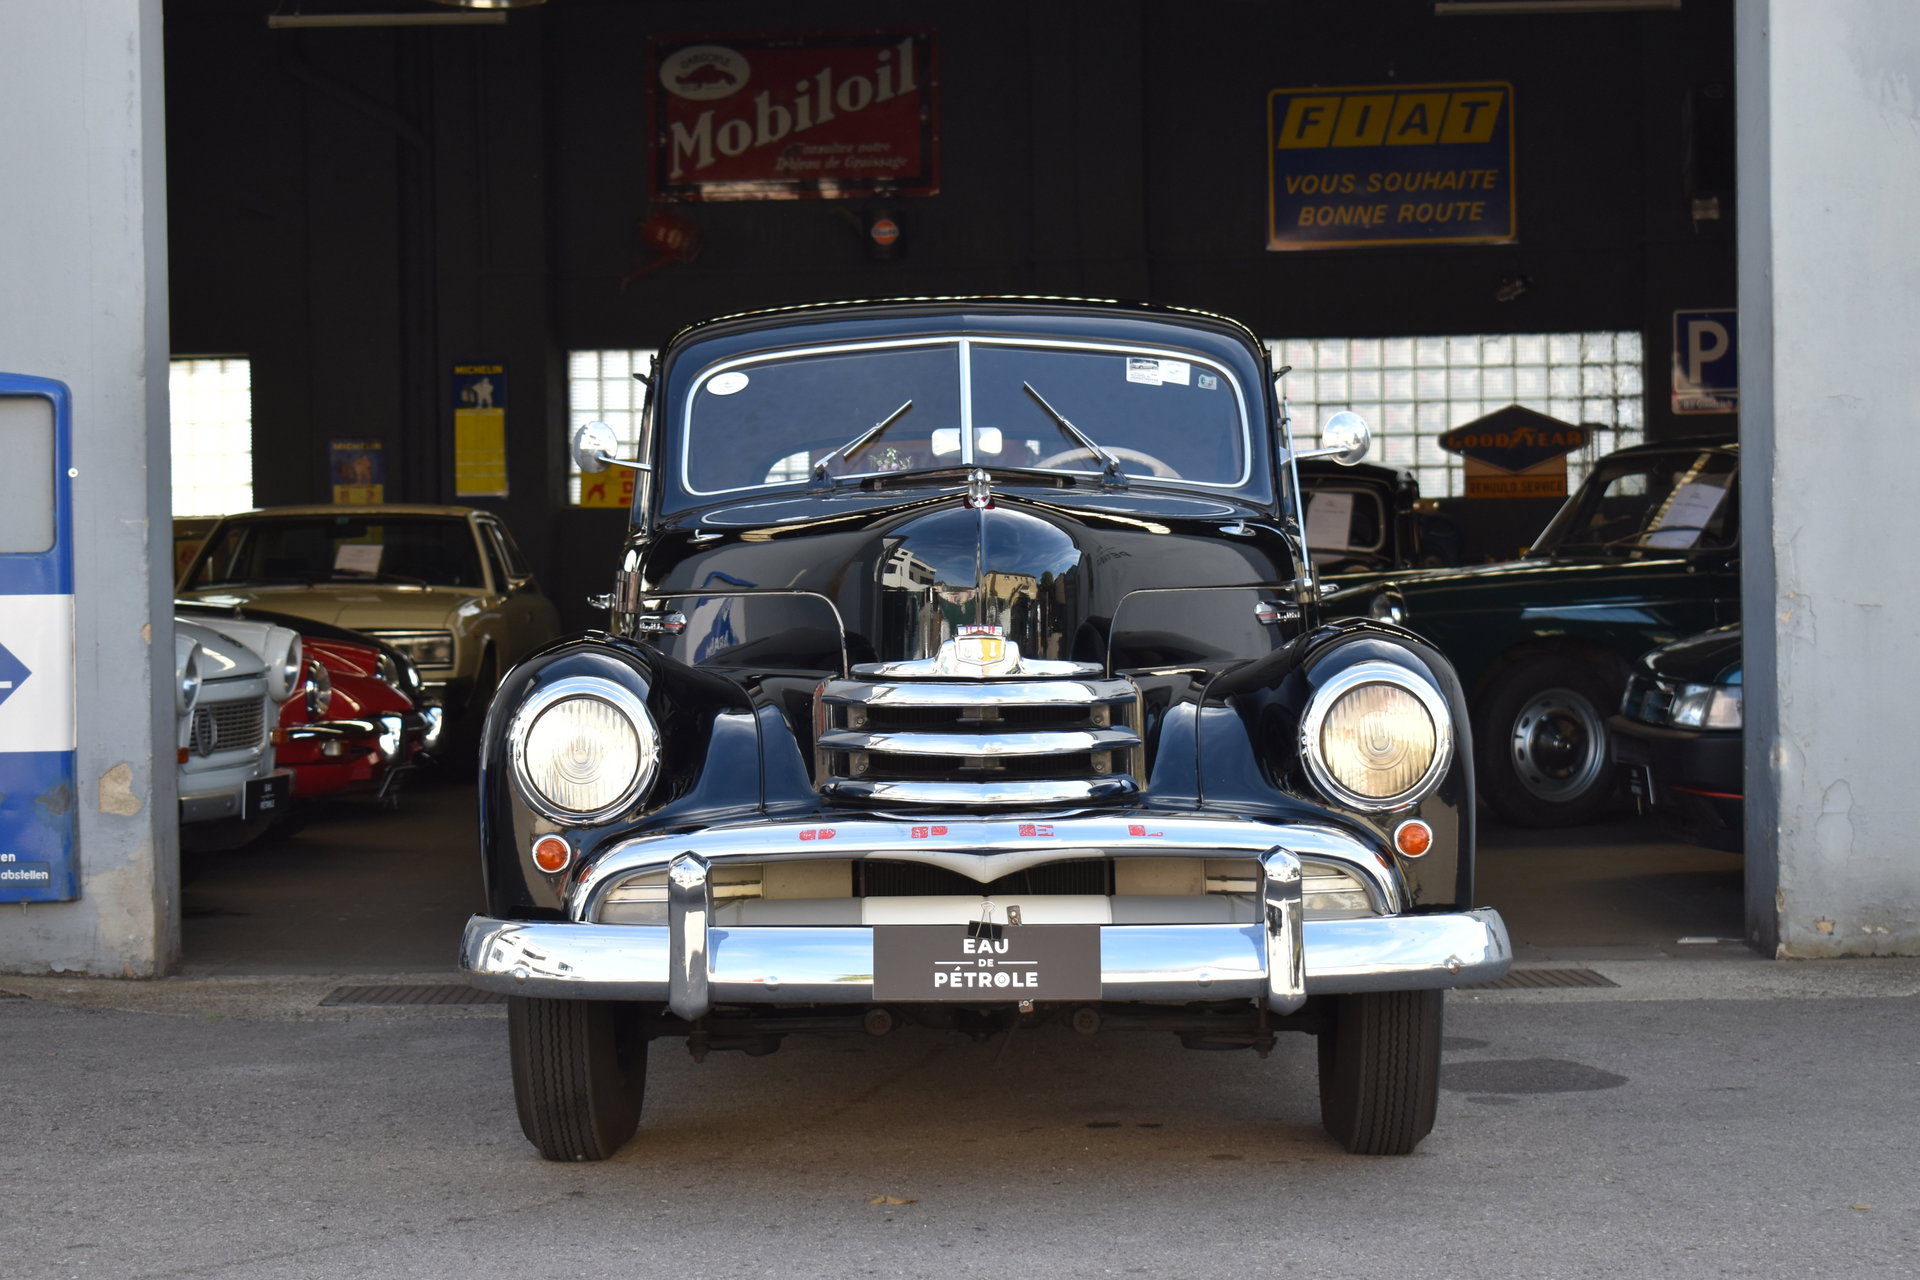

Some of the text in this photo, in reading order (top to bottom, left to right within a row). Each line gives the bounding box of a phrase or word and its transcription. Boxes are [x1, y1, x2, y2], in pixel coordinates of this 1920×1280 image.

[669, 37, 917, 179] Mobiloil
[1294, 99, 1491, 141] FIAT
[1286, 169, 1499, 195] VOUS SOUHAITE
[1298, 201, 1486, 226] BONNE ROUTE
[1688, 320, 1729, 384] P
[454, 365, 503, 375] MICHELIN
[1447, 427, 1583, 450] GOODYEAR
[1, 869, 49, 880] abstellen
[963, 938, 1009, 954] EAU
[978, 958, 994, 967] DE
[934, 966, 1039, 988] PÉTROLE
